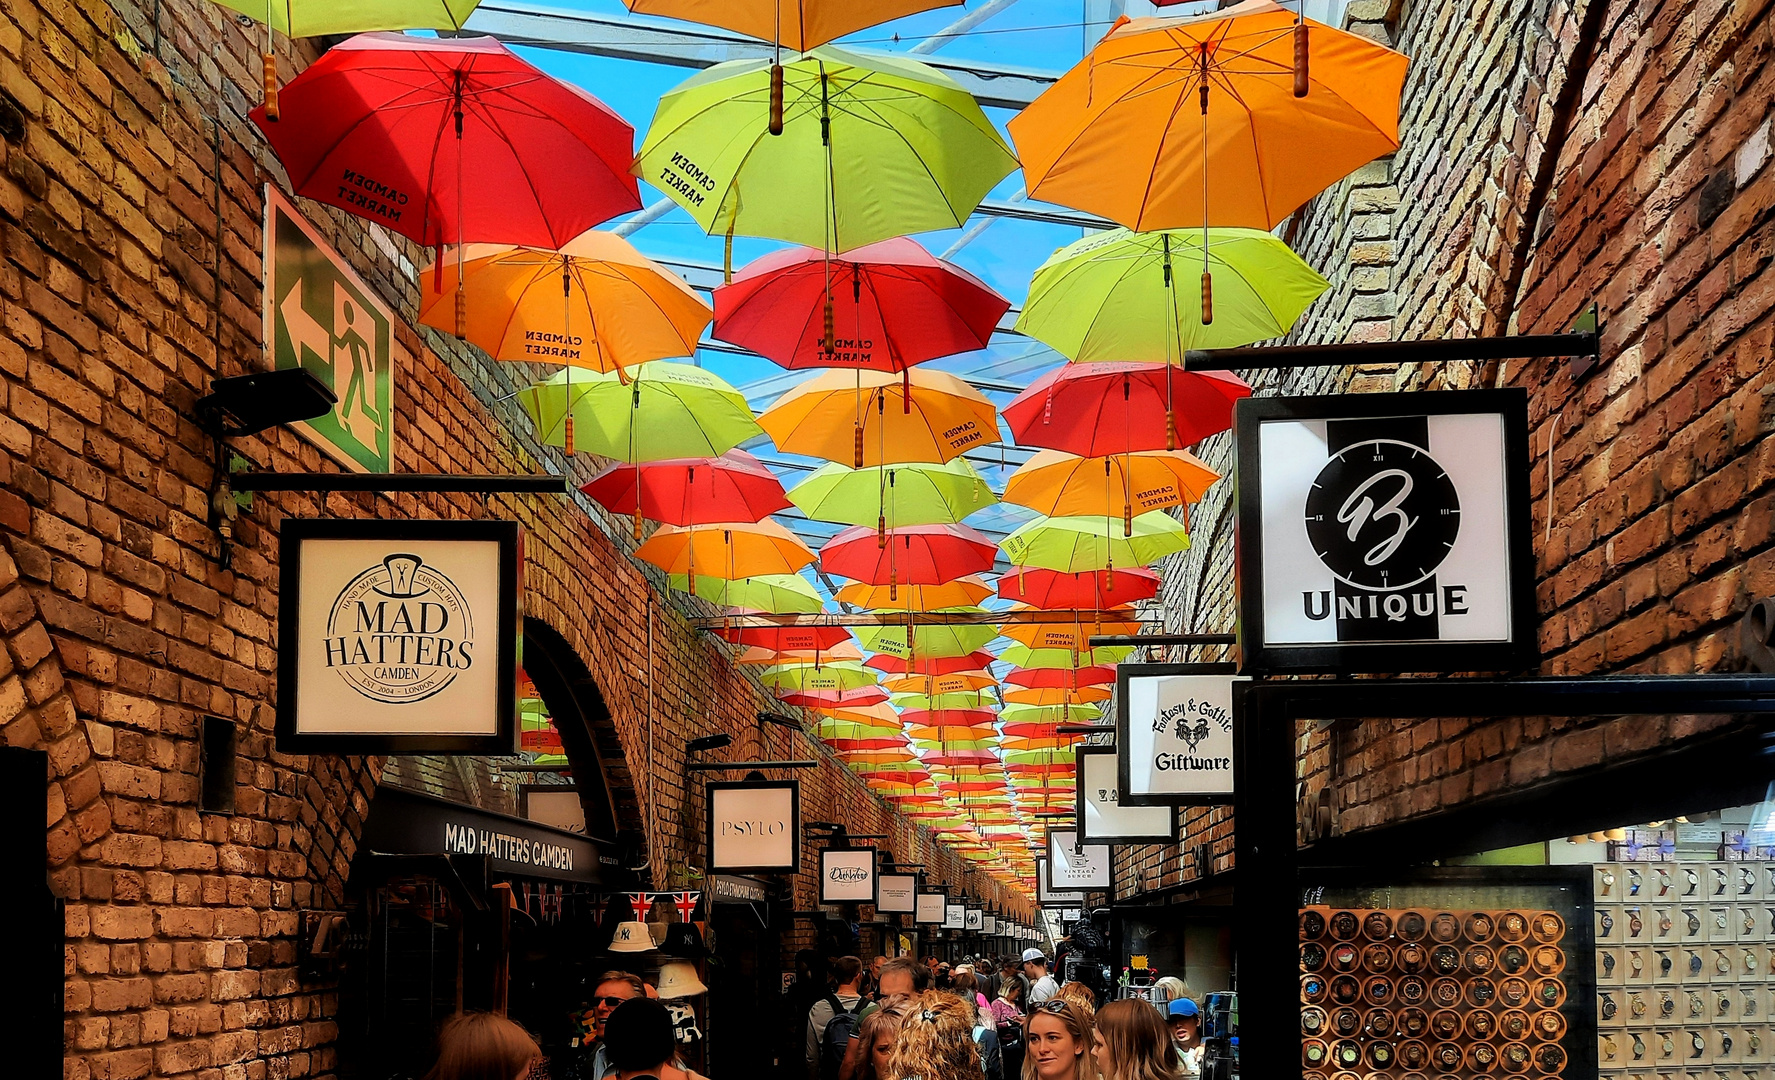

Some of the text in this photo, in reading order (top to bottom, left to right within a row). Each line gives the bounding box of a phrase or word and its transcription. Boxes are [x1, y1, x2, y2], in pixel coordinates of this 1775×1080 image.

[342, 576, 380, 610] HAND MADE
[417, 574, 459, 612] CUSTOM HATS
[1301, 585, 1469, 622] UNIQUE
[353, 601, 449, 634] MAD
[323, 635, 474, 670] HATTERS
[361, 678, 375, 689] EST
[378, 686, 394, 695] 2004
[404, 679, 435, 694] LONDON
[373, 667, 420, 680] CAMDEN
[1152, 698, 1233, 734] Fantasy & Gothic
[1155, 752, 1231, 772] Giftware
[721, 821, 785, 836] PSYLO
[445, 822, 574, 871] MAD HATTERS CAMDEN
